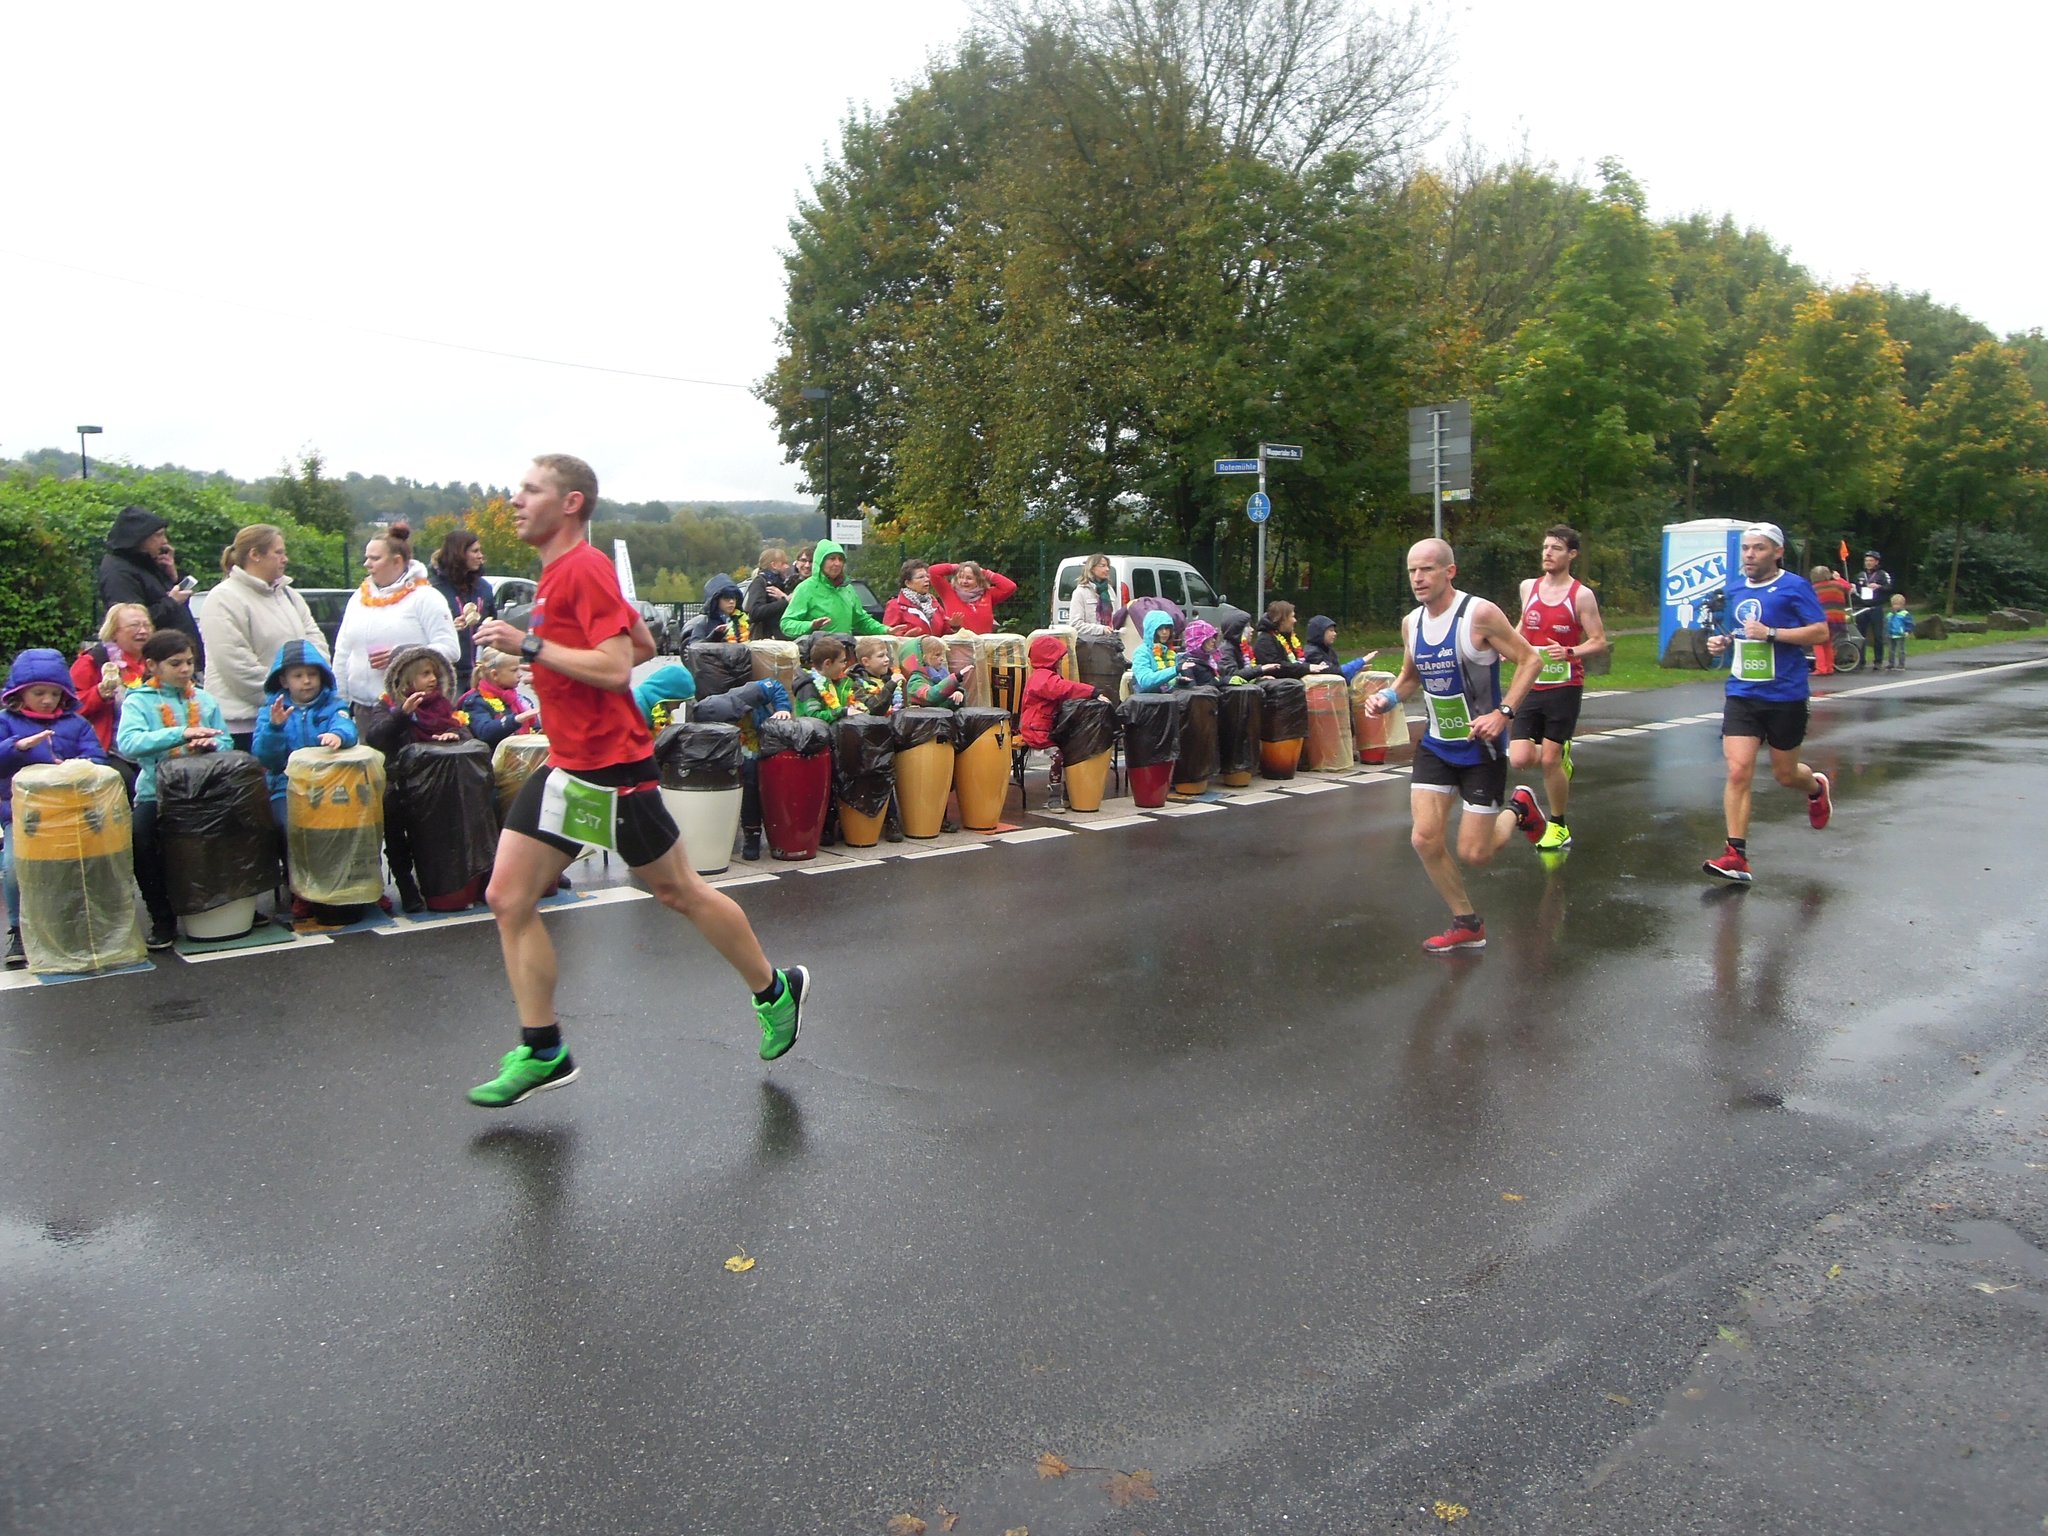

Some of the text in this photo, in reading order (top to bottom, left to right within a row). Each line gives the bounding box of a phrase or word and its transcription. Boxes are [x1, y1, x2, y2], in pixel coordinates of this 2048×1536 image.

[1220, 463, 1257, 471] Rotemühle
[1542, 663, 1565, 674] 466
[1743, 659, 1768, 670] 689
[1437, 716, 1465, 729] 208
